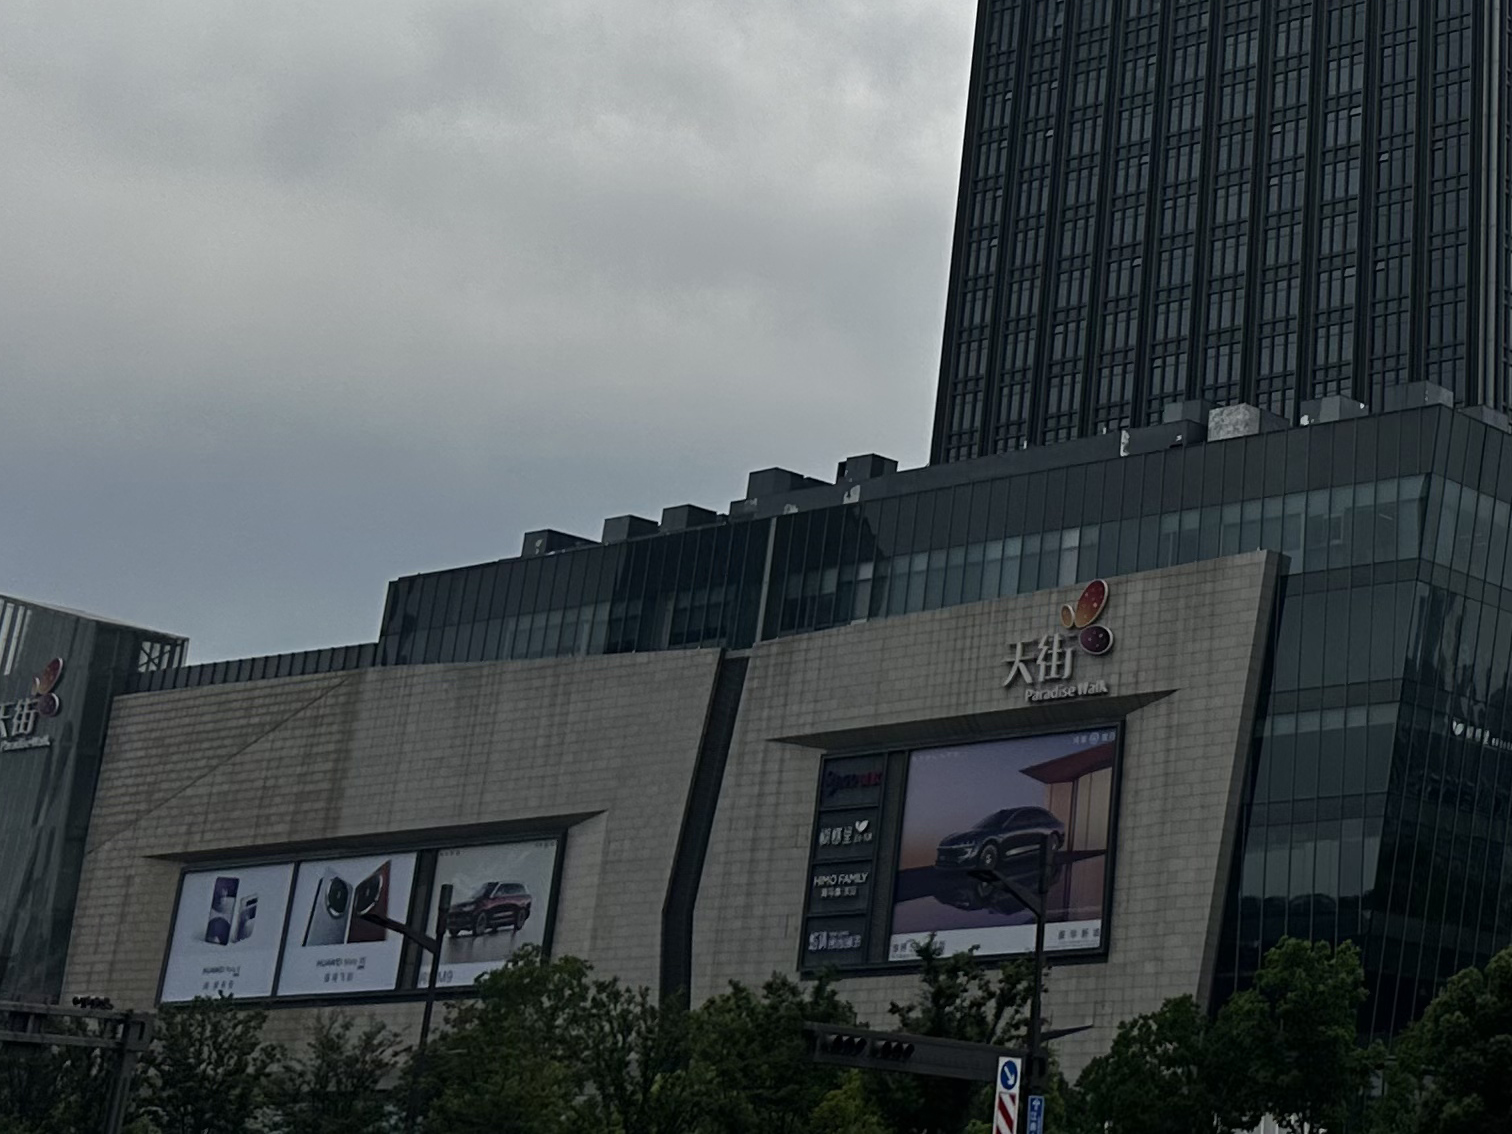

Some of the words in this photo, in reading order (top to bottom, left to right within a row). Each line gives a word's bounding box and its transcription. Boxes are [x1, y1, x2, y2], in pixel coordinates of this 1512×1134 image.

[1001, 633, 1078, 688] 天街
[1025, 684, 1076, 702] Paradise
[1077, 679, 1108, 696] Walk
